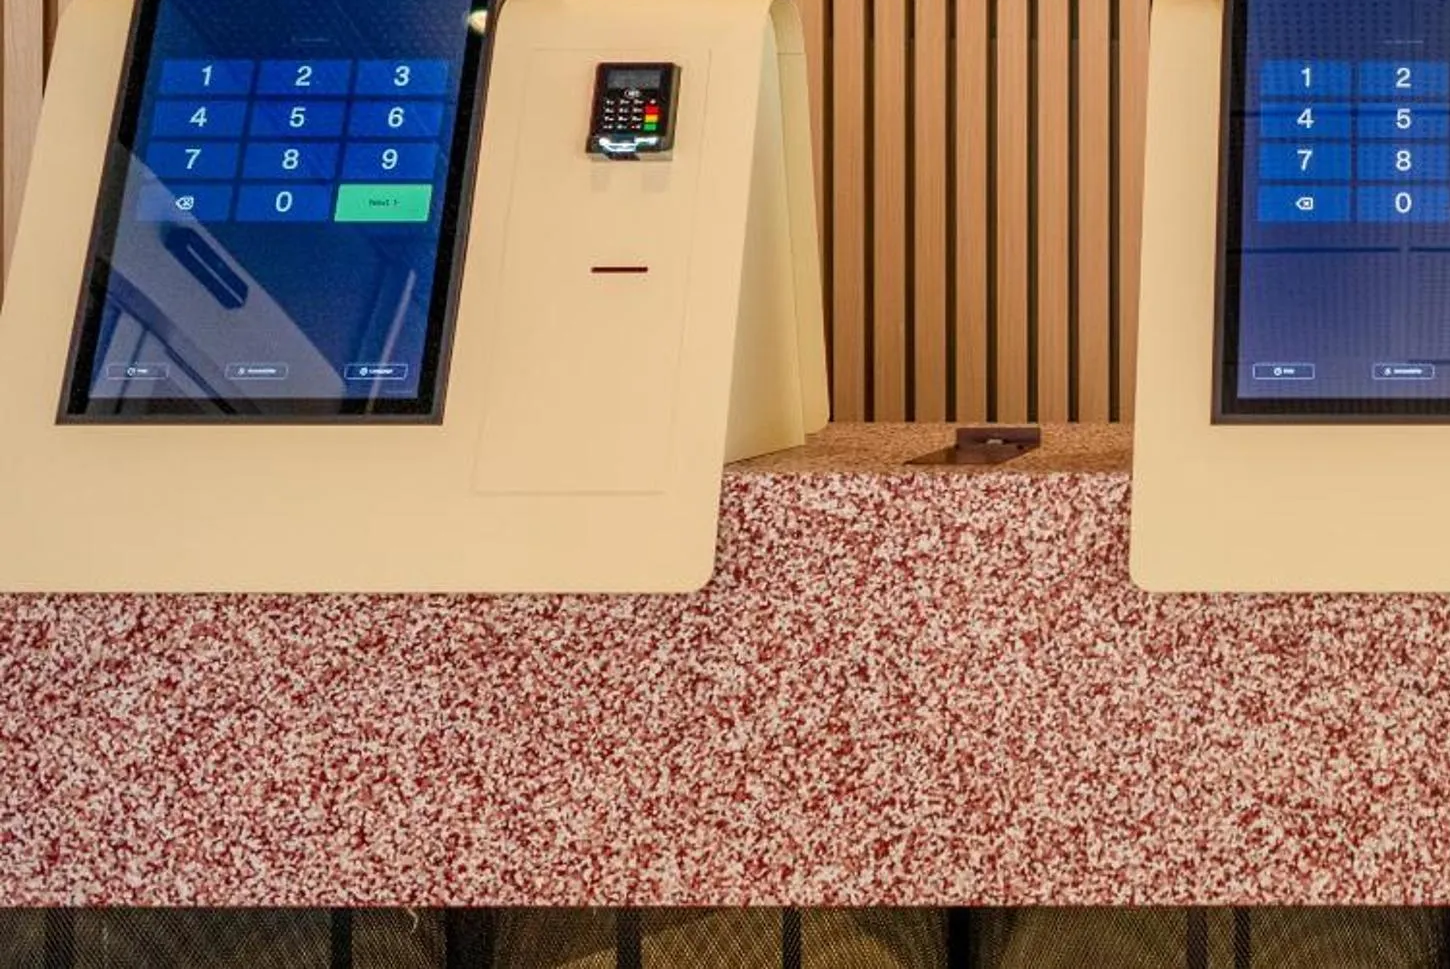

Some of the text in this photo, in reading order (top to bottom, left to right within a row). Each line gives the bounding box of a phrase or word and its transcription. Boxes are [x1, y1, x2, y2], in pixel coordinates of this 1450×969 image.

[203, 66, 409, 86] 1 2 3
[1302, 68, 1310, 87] 1
[1397, 68, 1410, 87] 2
[190, 107, 403, 127] 4 5 6
[1298, 109, 1313, 128] 4
[1397, 109, 1411, 128] 5
[186, 149, 397, 169] 7 8 9
[1298, 150, 1312, 170] 7
[1396, 151, 1411, 171] 8
[276, 192, 292, 212] 0
[1396, 192, 1411, 213] 0
